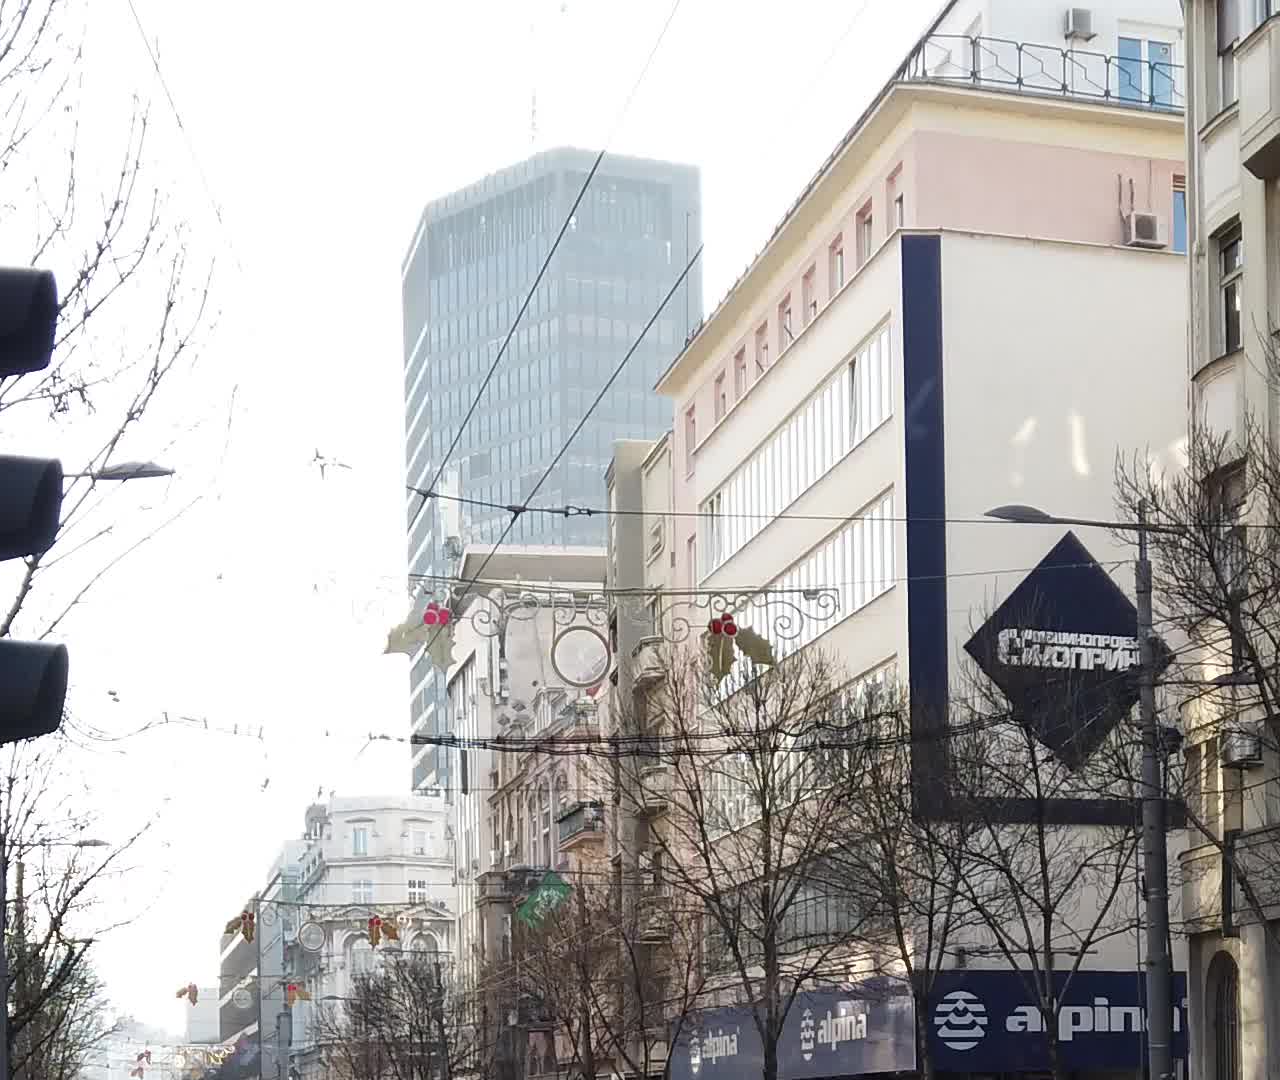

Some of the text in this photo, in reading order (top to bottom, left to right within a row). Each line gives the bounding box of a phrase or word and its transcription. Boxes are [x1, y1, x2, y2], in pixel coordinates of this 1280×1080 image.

[817, 1009, 867, 1051] alpina
[1006, 997, 1180, 1041] apin
[702, 1028, 738, 1065] alpina
